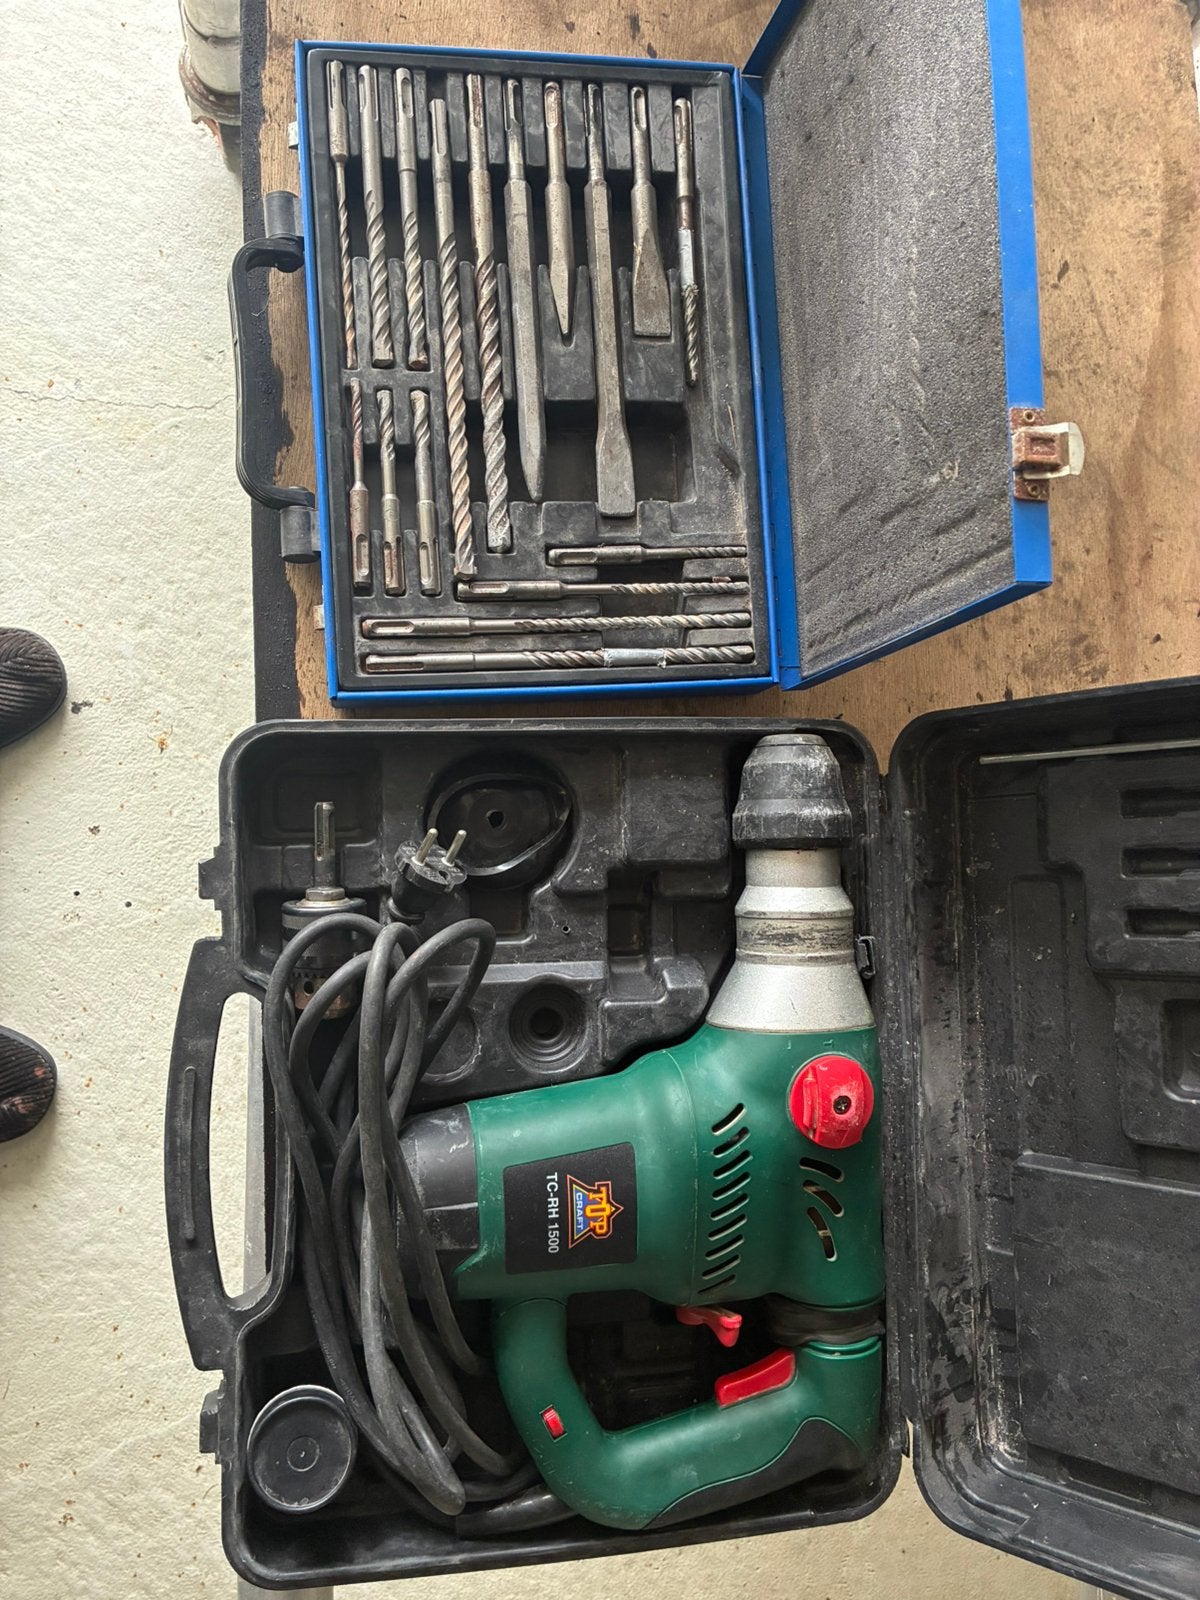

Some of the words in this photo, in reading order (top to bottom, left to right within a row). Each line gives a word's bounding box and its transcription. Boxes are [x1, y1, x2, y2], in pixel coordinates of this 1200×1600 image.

[546, 1172, 560, 1219] TC-RH
[575, 1192, 584, 1230] CRAFT
[585, 1186, 612, 1235] TOP
[547, 1222, 560, 1254] 1500
